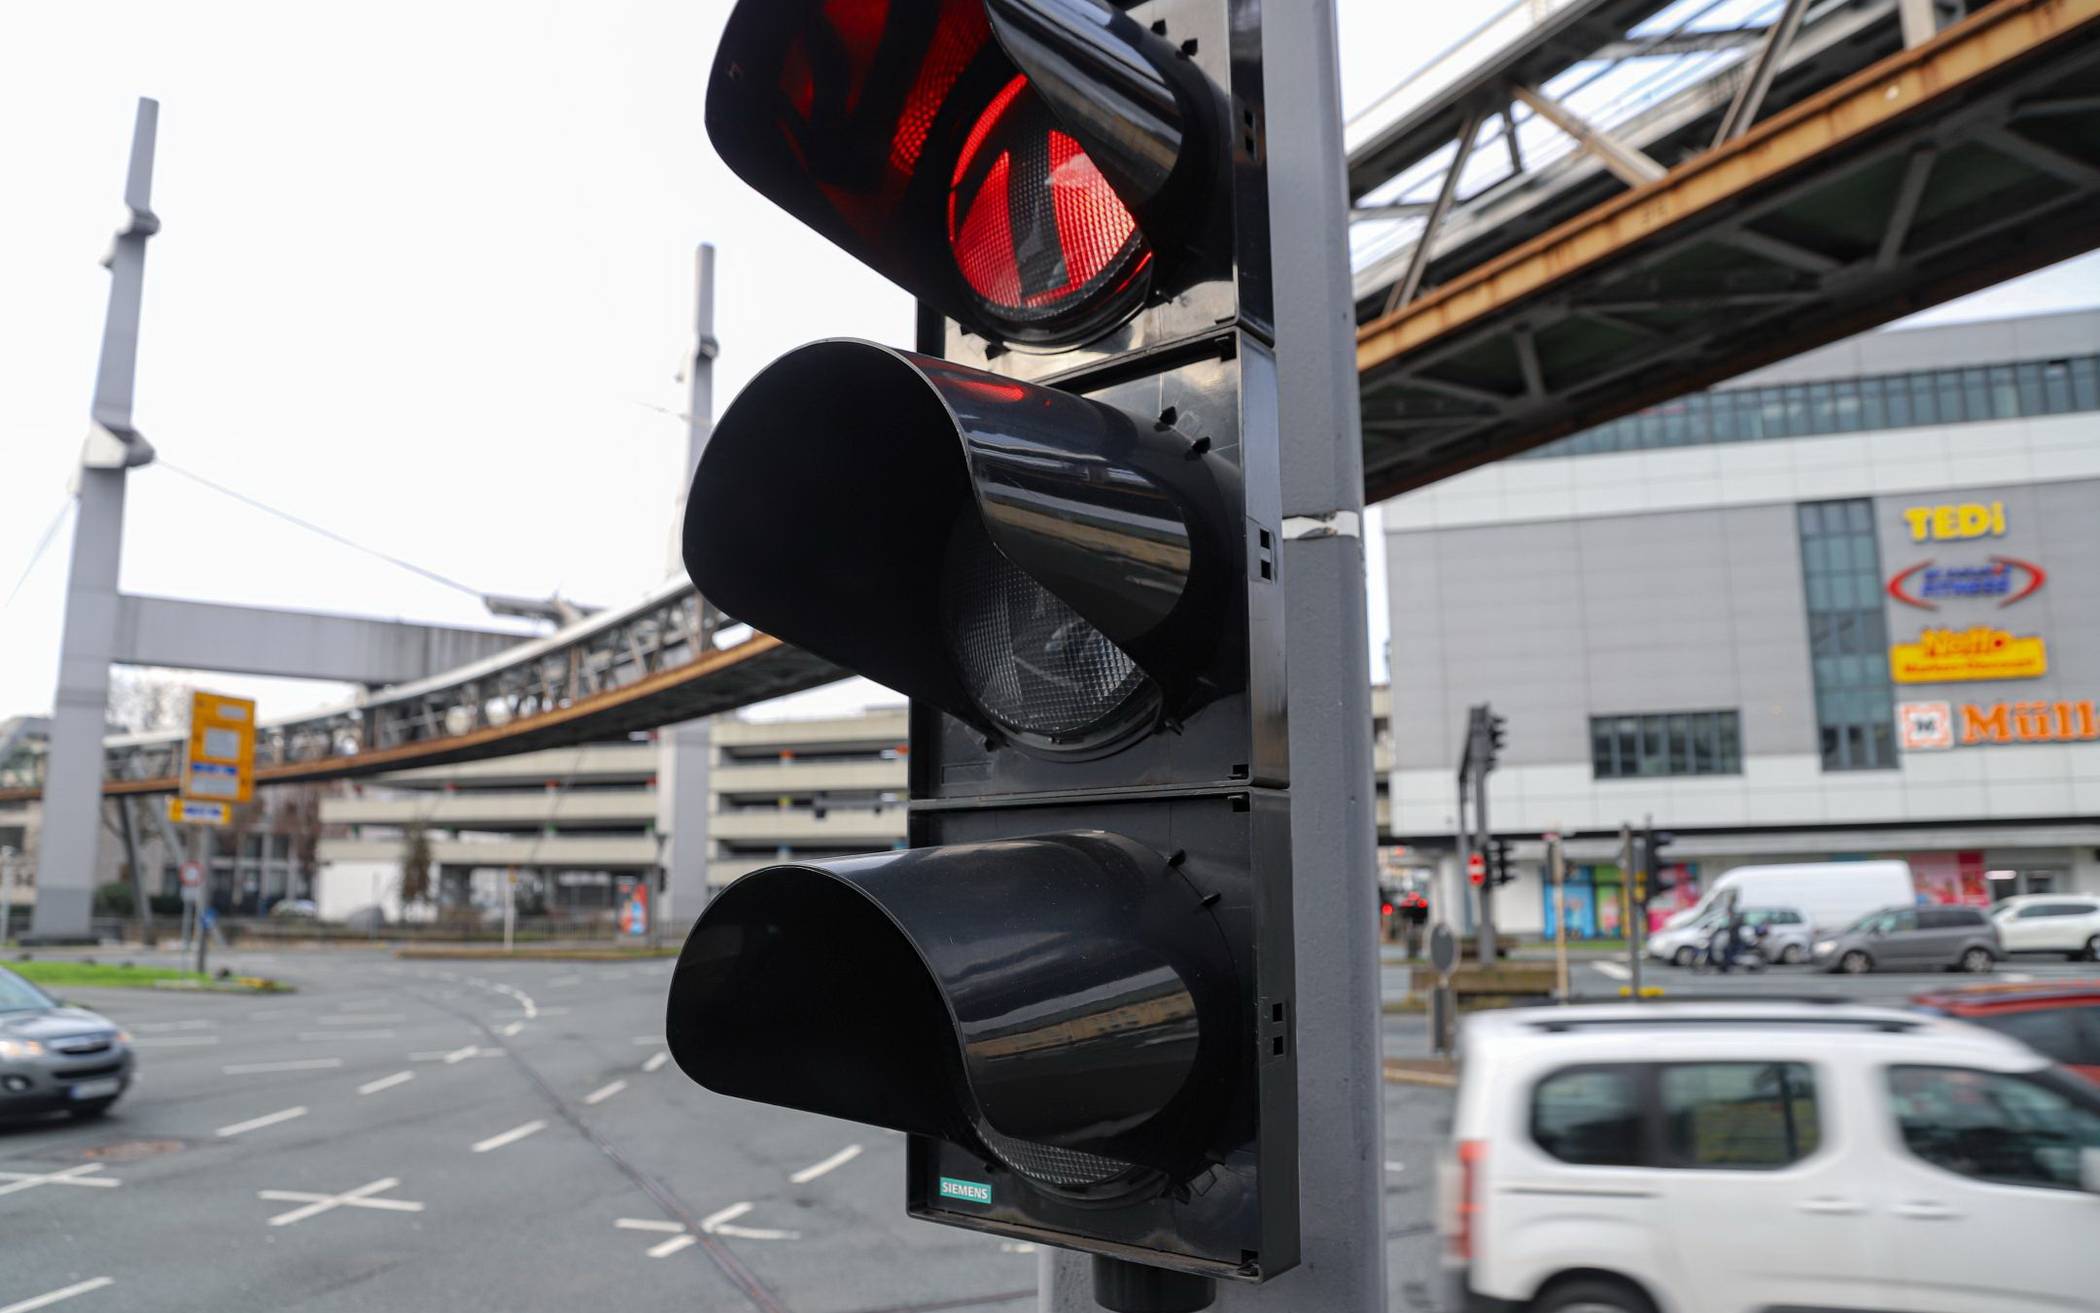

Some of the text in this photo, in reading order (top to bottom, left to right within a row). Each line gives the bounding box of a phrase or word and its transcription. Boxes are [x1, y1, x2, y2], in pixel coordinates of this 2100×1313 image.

[1904, 502, 2006, 541] TEDi
[1960, 700, 2100, 743] Müll
[942, 1181, 989, 1200] SIEMENS
